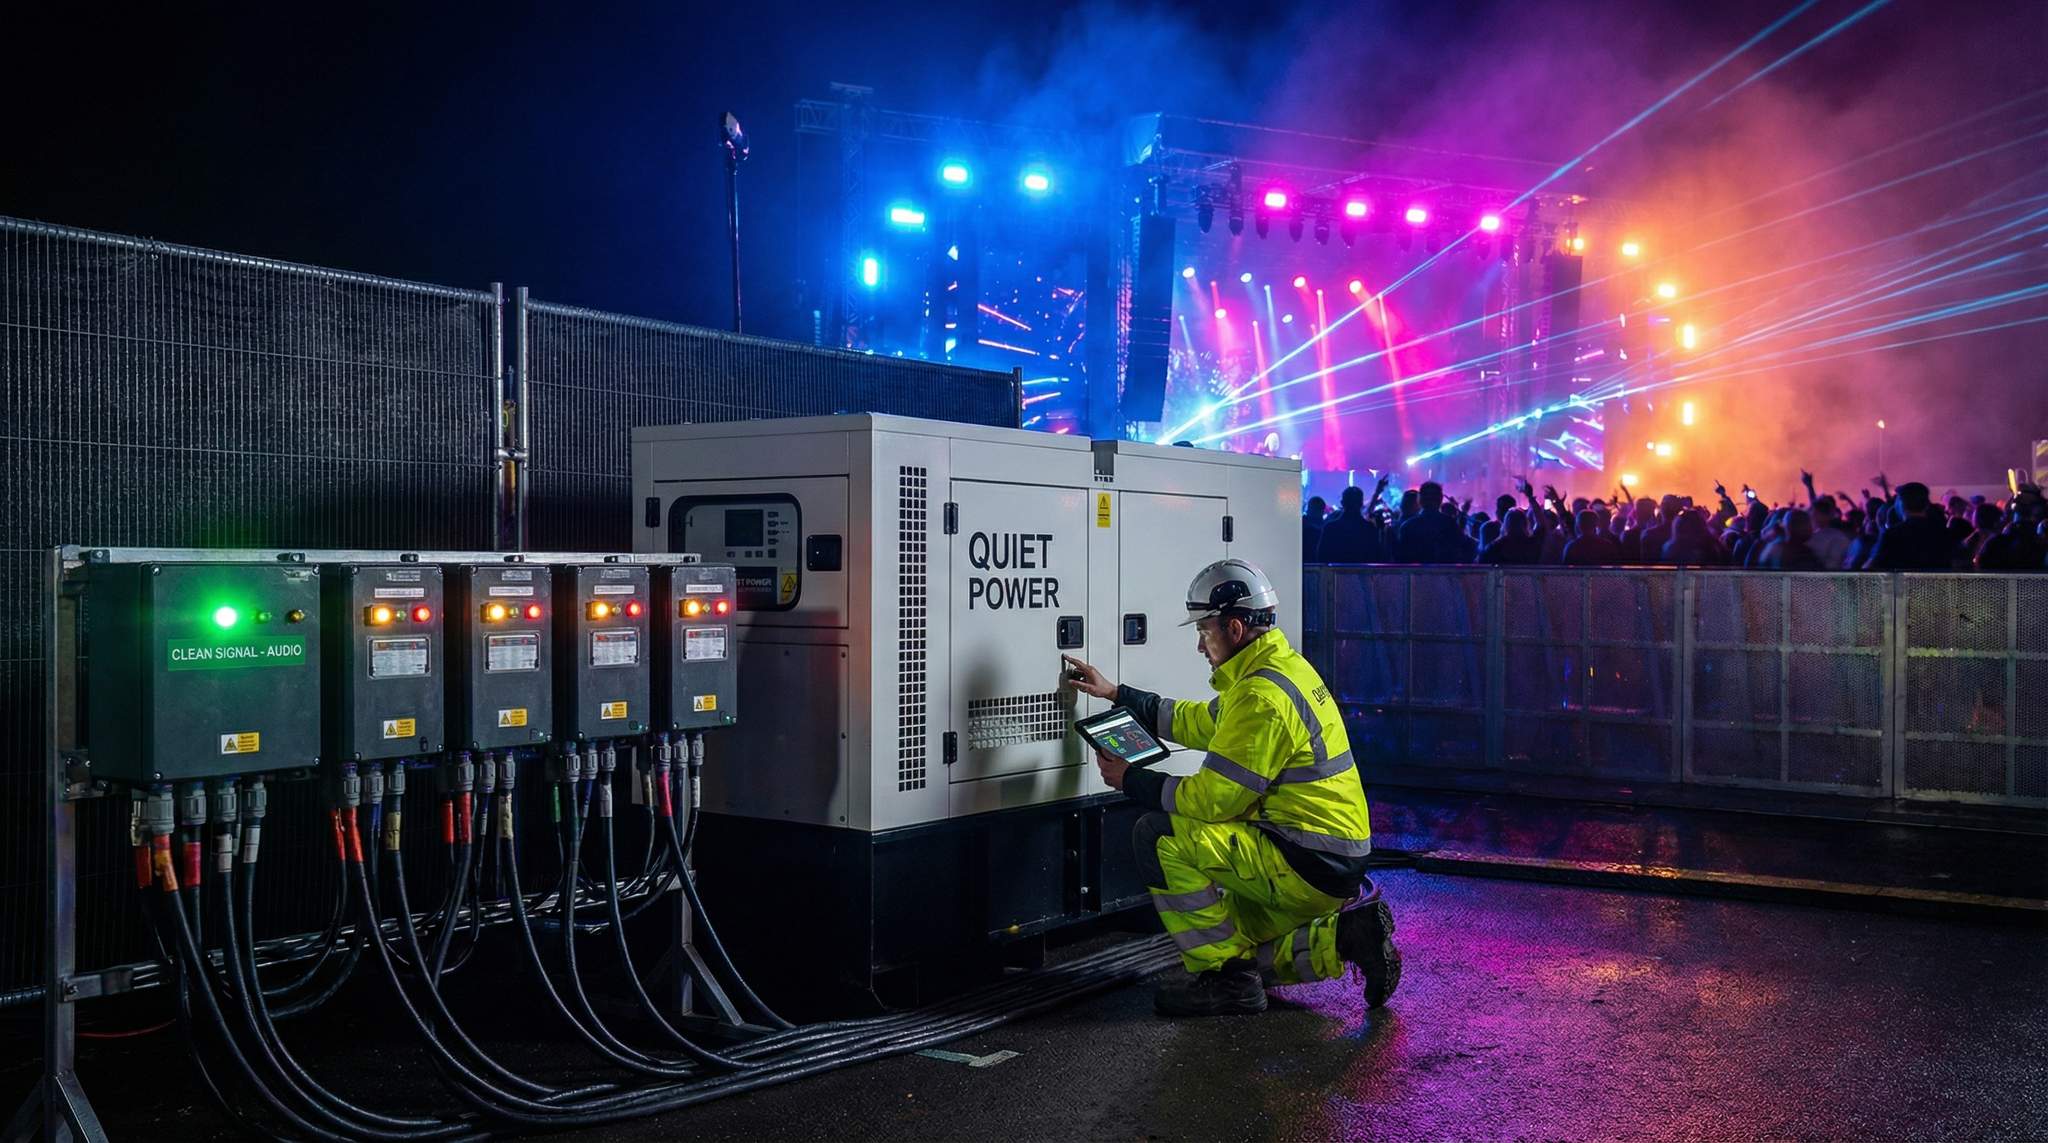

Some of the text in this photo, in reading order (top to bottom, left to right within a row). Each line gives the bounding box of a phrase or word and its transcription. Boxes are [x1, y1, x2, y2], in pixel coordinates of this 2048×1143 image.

[969, 532, 1053, 571] QUIET
[969, 577, 1060, 610] POWER
[171, 647, 213, 661] CLEAN
[215, 646, 258, 659] SIGNAL
[266, 644, 302, 657] AUDIO
